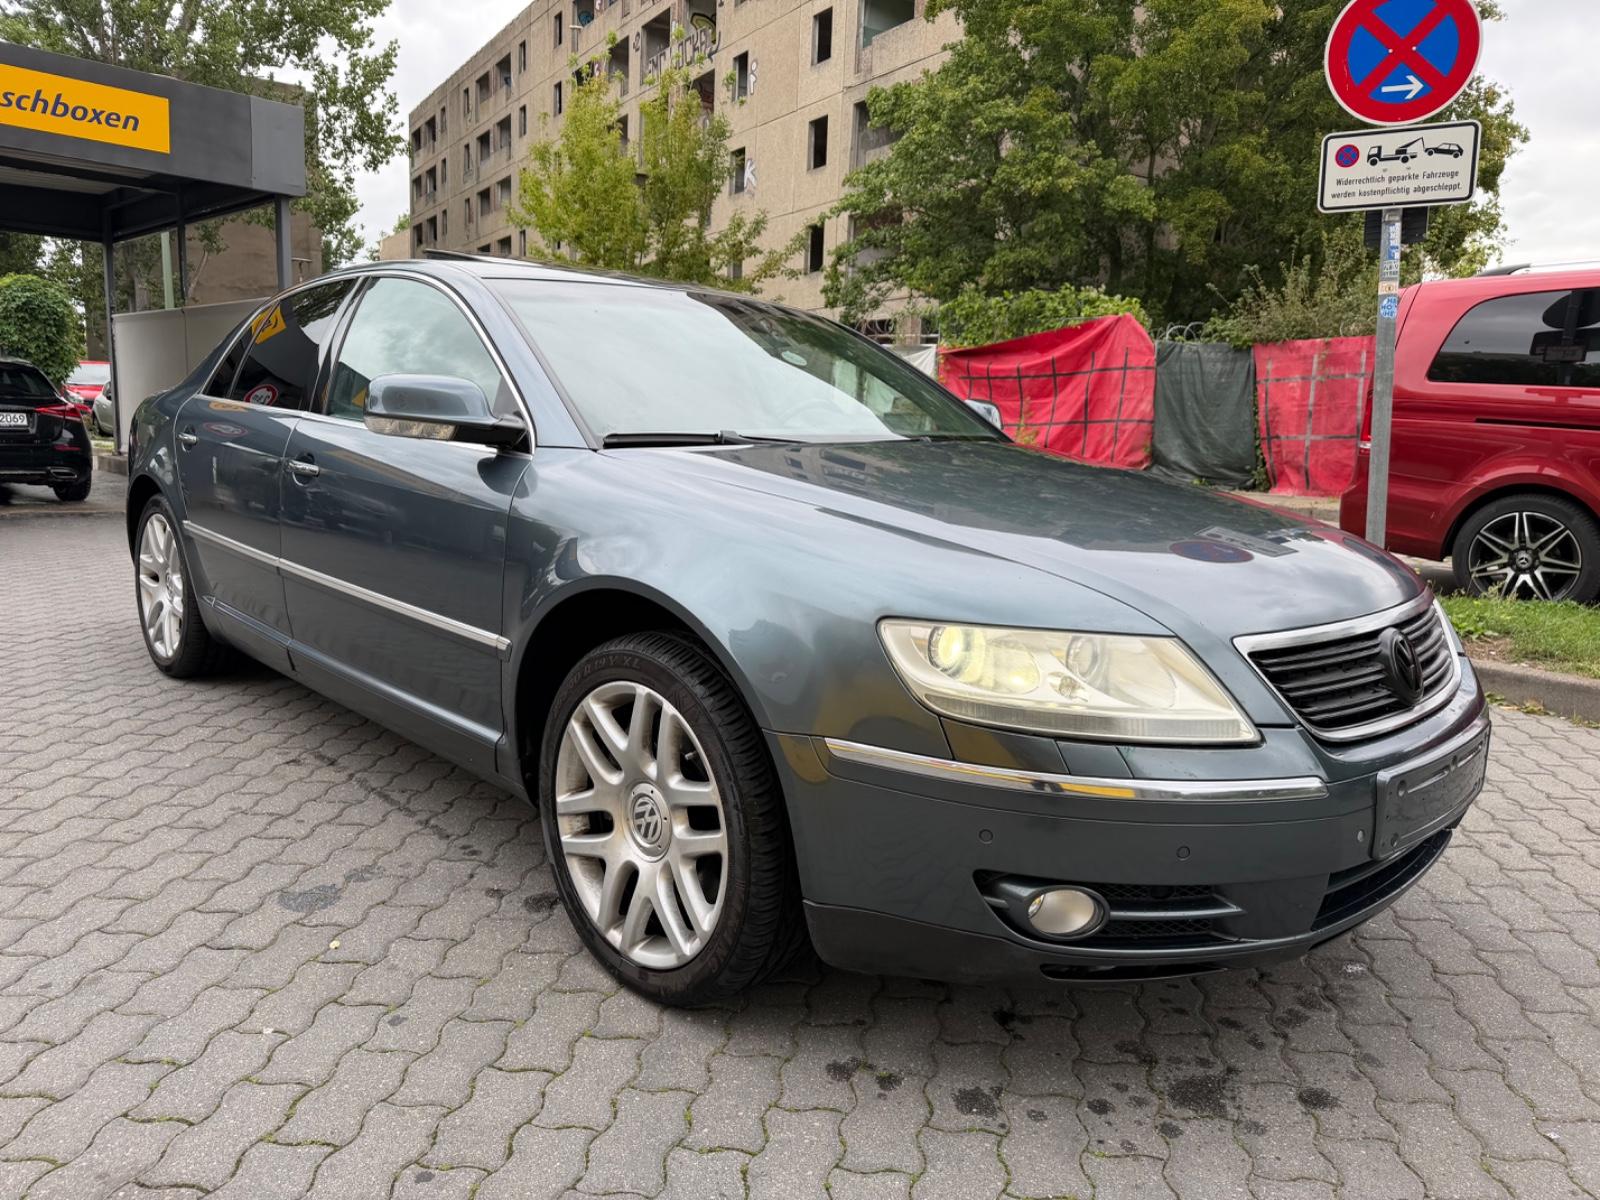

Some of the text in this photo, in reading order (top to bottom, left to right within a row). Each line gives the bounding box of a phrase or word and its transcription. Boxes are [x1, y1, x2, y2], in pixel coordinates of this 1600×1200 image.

[0, 89, 140, 131] schboxen
[1336, 170, 1459, 186] Widerrechtlich geparkte Fahrzeuge
[1331, 191, 1356, 199] werden
[1358, 185, 1410, 197] kostenpflichtig
[0, 413, 26, 424] 2069
